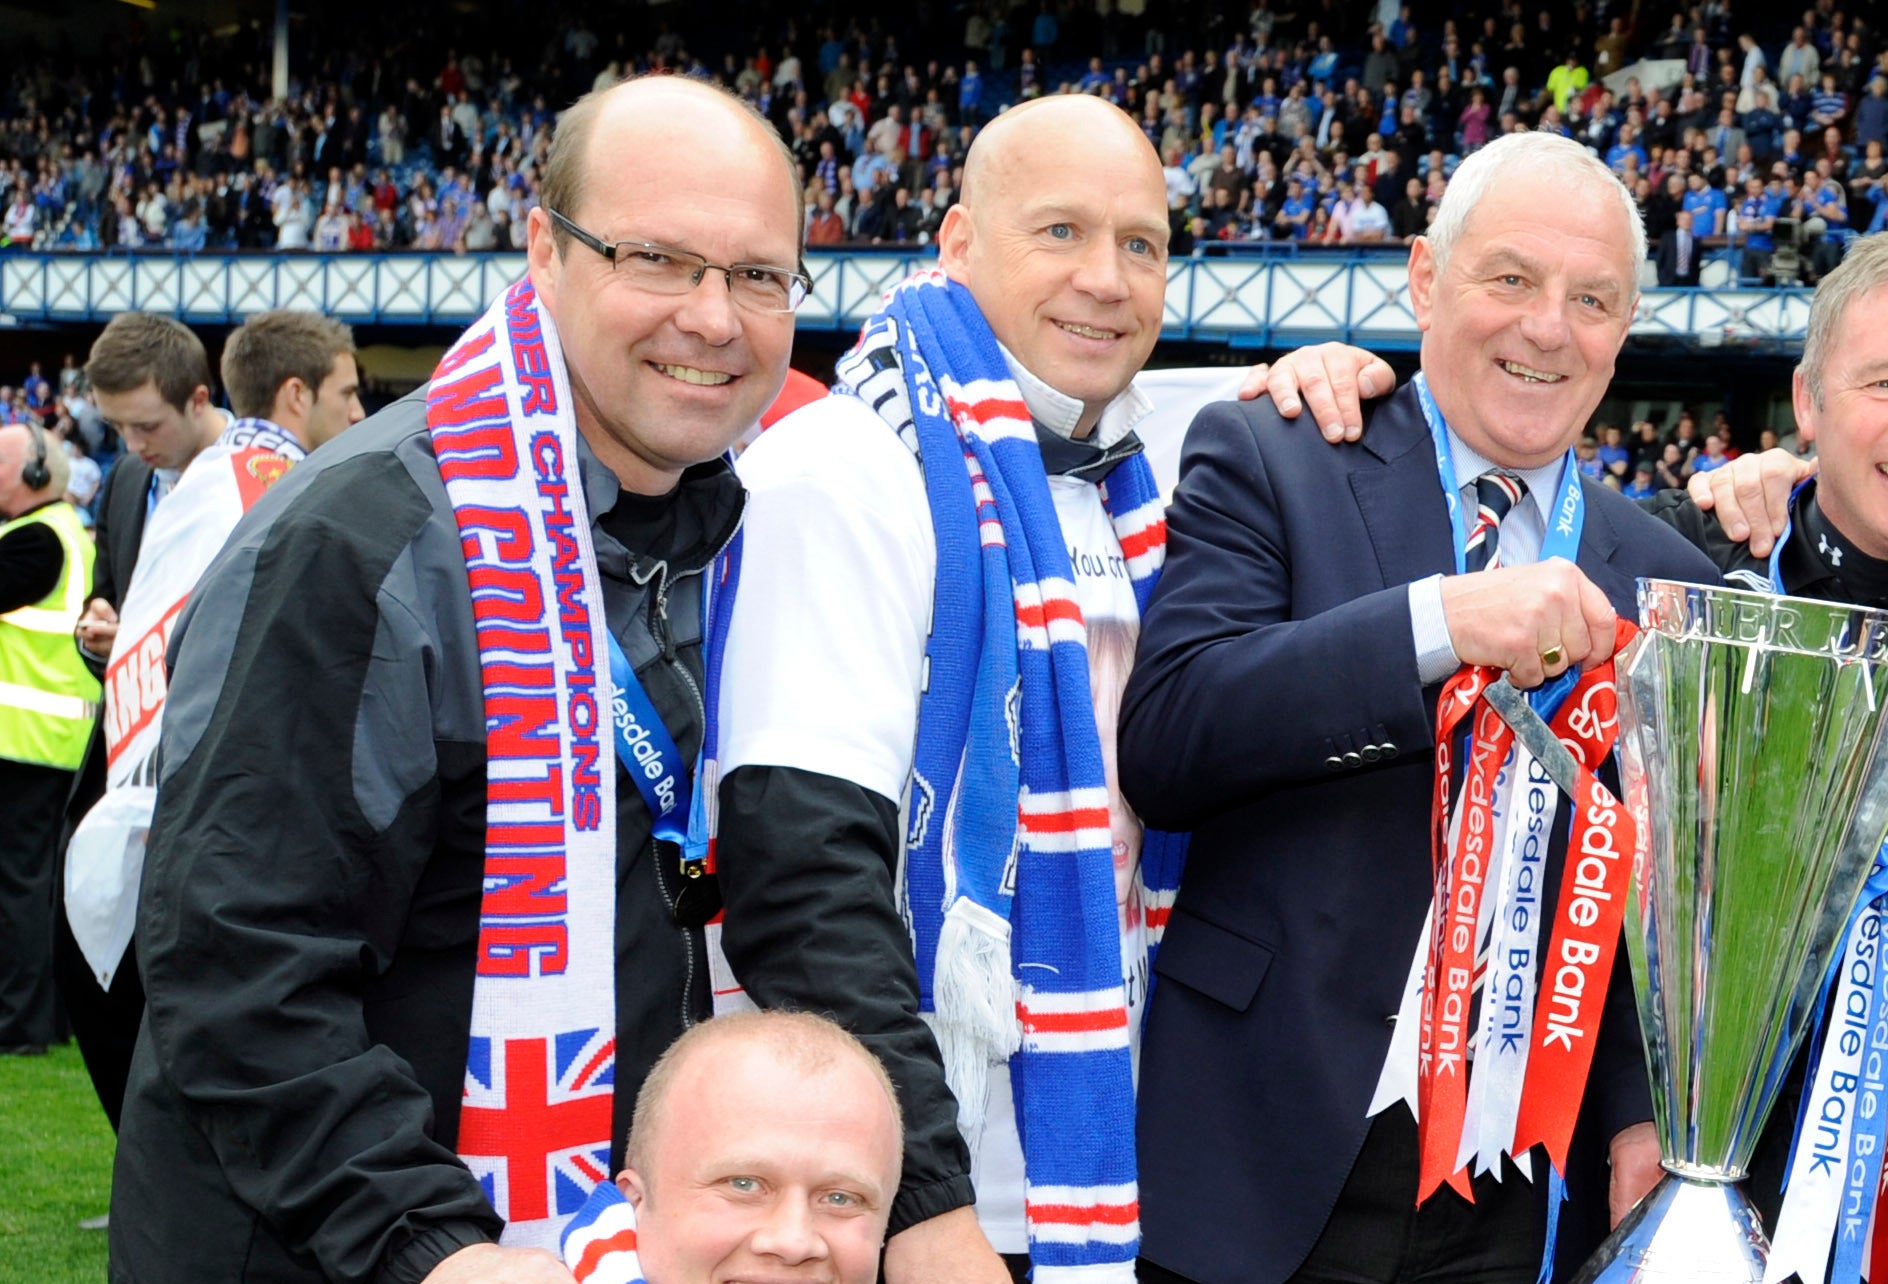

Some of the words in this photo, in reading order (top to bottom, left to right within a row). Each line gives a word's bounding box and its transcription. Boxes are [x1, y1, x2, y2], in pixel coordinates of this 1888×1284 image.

[1070, 546, 1106, 577] You
[1556, 485, 1581, 537] Bank
[529, 431, 601, 832] CHAMPIONS
[454, 505, 568, 978] COUNTING
[1453, 706, 1505, 954] Clydesdale
[1436, 967, 1470, 1078] Bank
[1499, 949, 1530, 1055] Bank
[1543, 938, 1601, 1053] Bank
[1809, 1070, 1858, 1178] Bank
[1844, 1133, 1876, 1242] Bank
